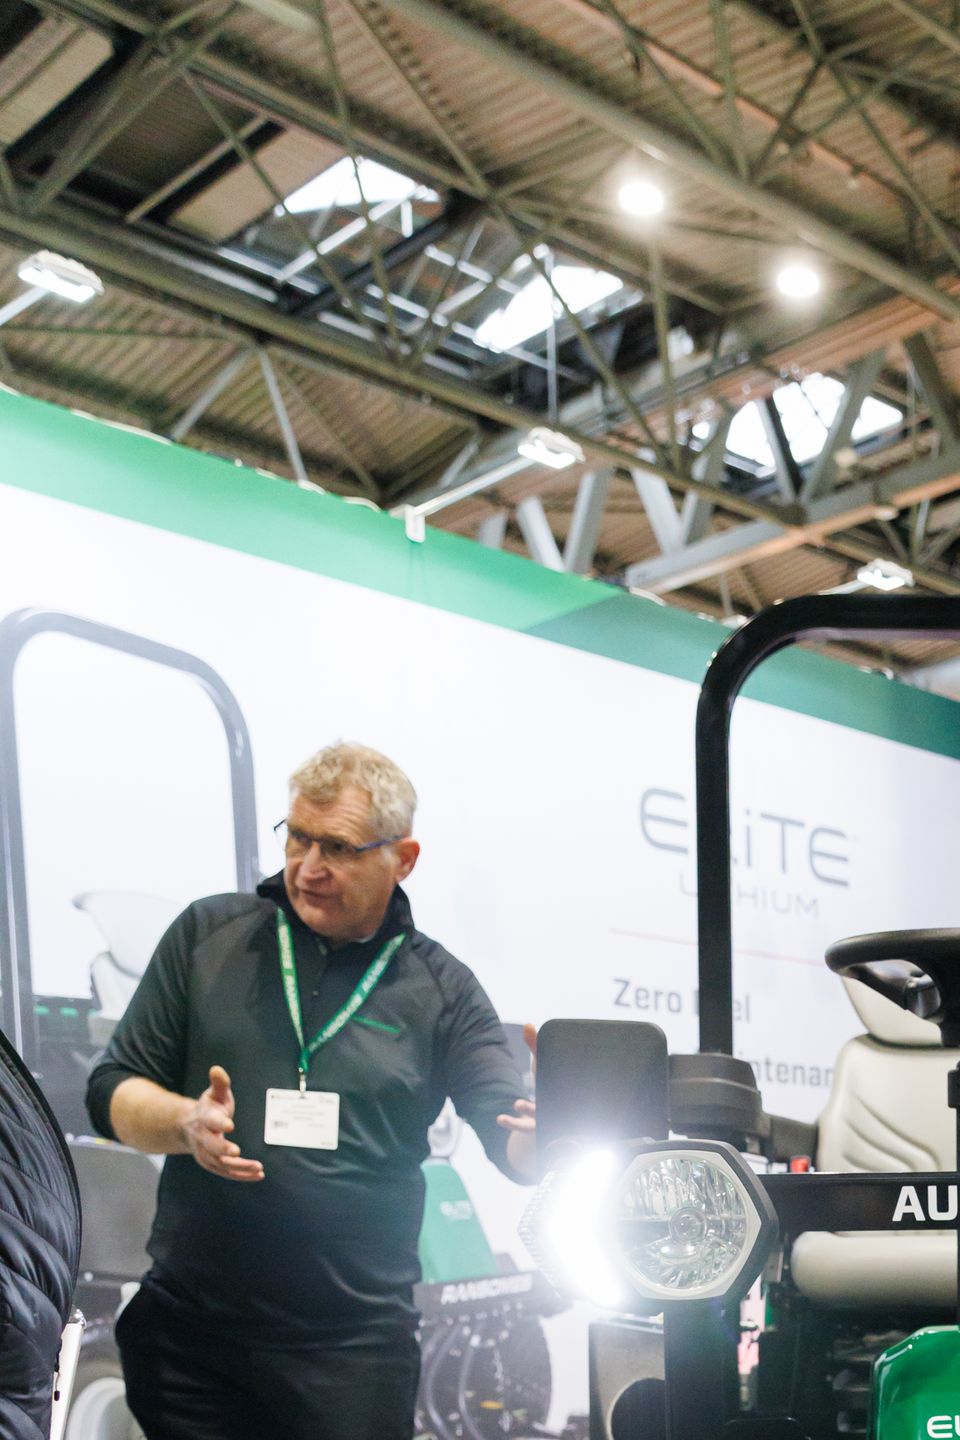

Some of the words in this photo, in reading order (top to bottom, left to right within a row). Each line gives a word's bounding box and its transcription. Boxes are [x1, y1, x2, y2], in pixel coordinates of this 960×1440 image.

[640, 787, 849, 887] EiTE
[679, 871, 820, 920] LHIUM
[613, 978, 682, 1014] Zero
